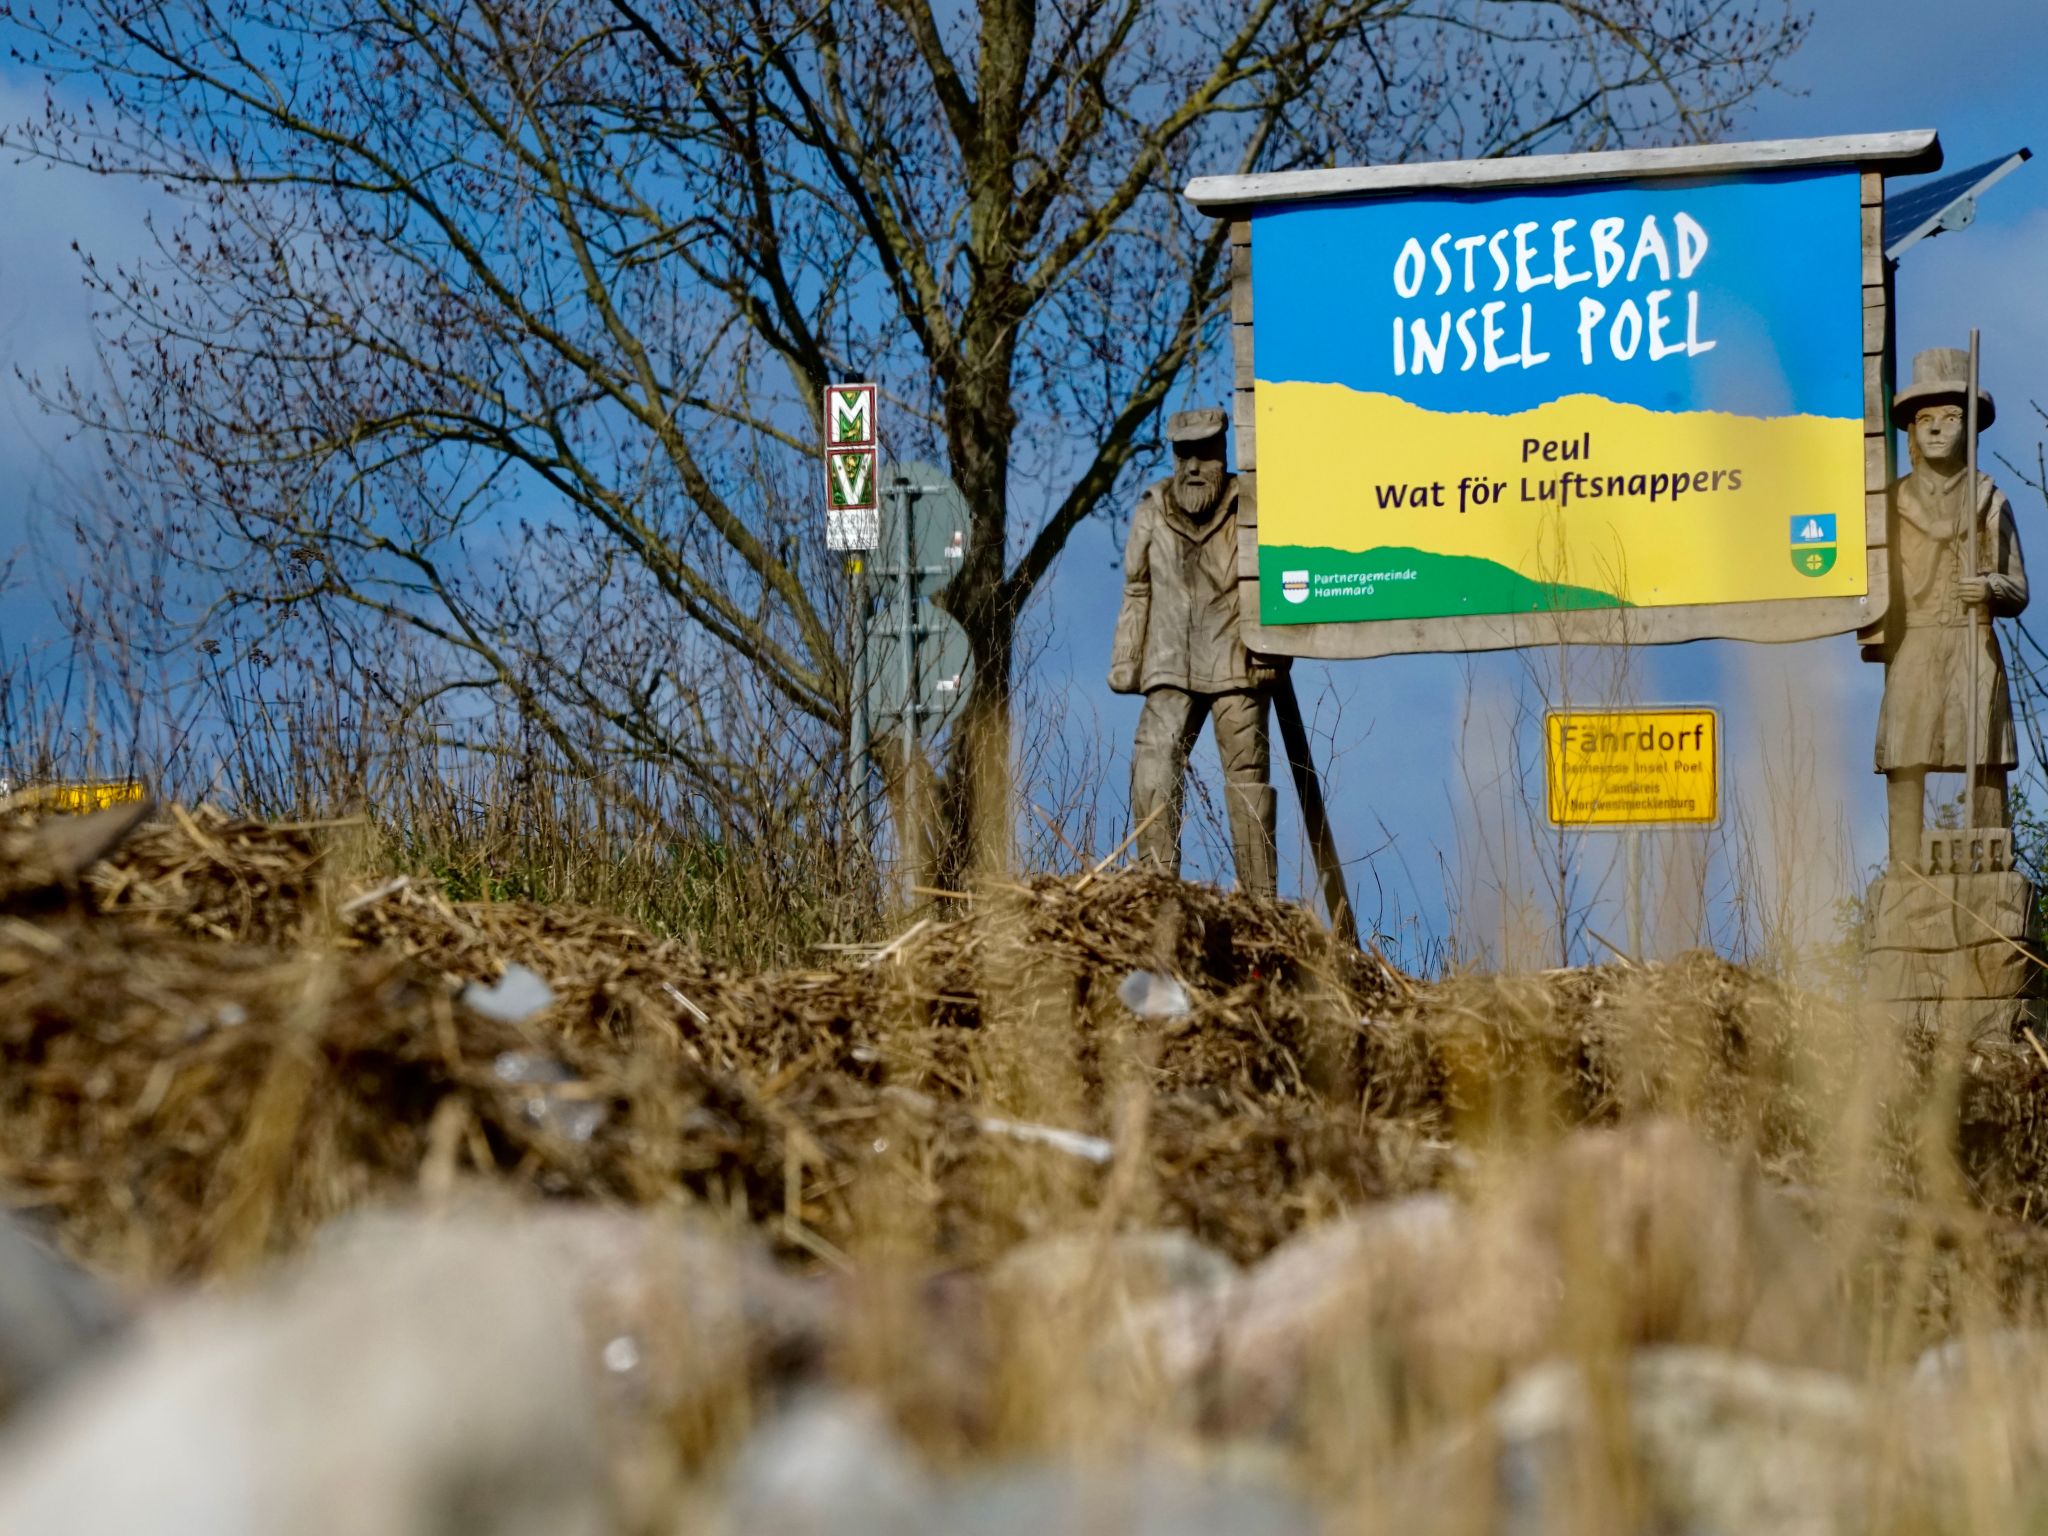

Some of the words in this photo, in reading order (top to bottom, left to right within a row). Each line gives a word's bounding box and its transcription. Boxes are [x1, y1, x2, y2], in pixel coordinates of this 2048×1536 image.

[1394, 212, 1708, 298] OSTSEEBAD
[1394, 301, 1551, 376] INSEL
[1577, 290, 1717, 366] POEL
[830, 390, 871, 443] M
[1521, 432, 1591, 463] Peul
[831, 453, 873, 505] V
[1375, 481, 1446, 509] Wat
[1458, 476, 1508, 513] för
[1520, 468, 1743, 507] Luftsnappers
[1314, 568, 1418, 585] Partnergemeinde
[1562, 724, 1704, 752] Fährdorf
[1674, 760, 1703, 773] Poel
